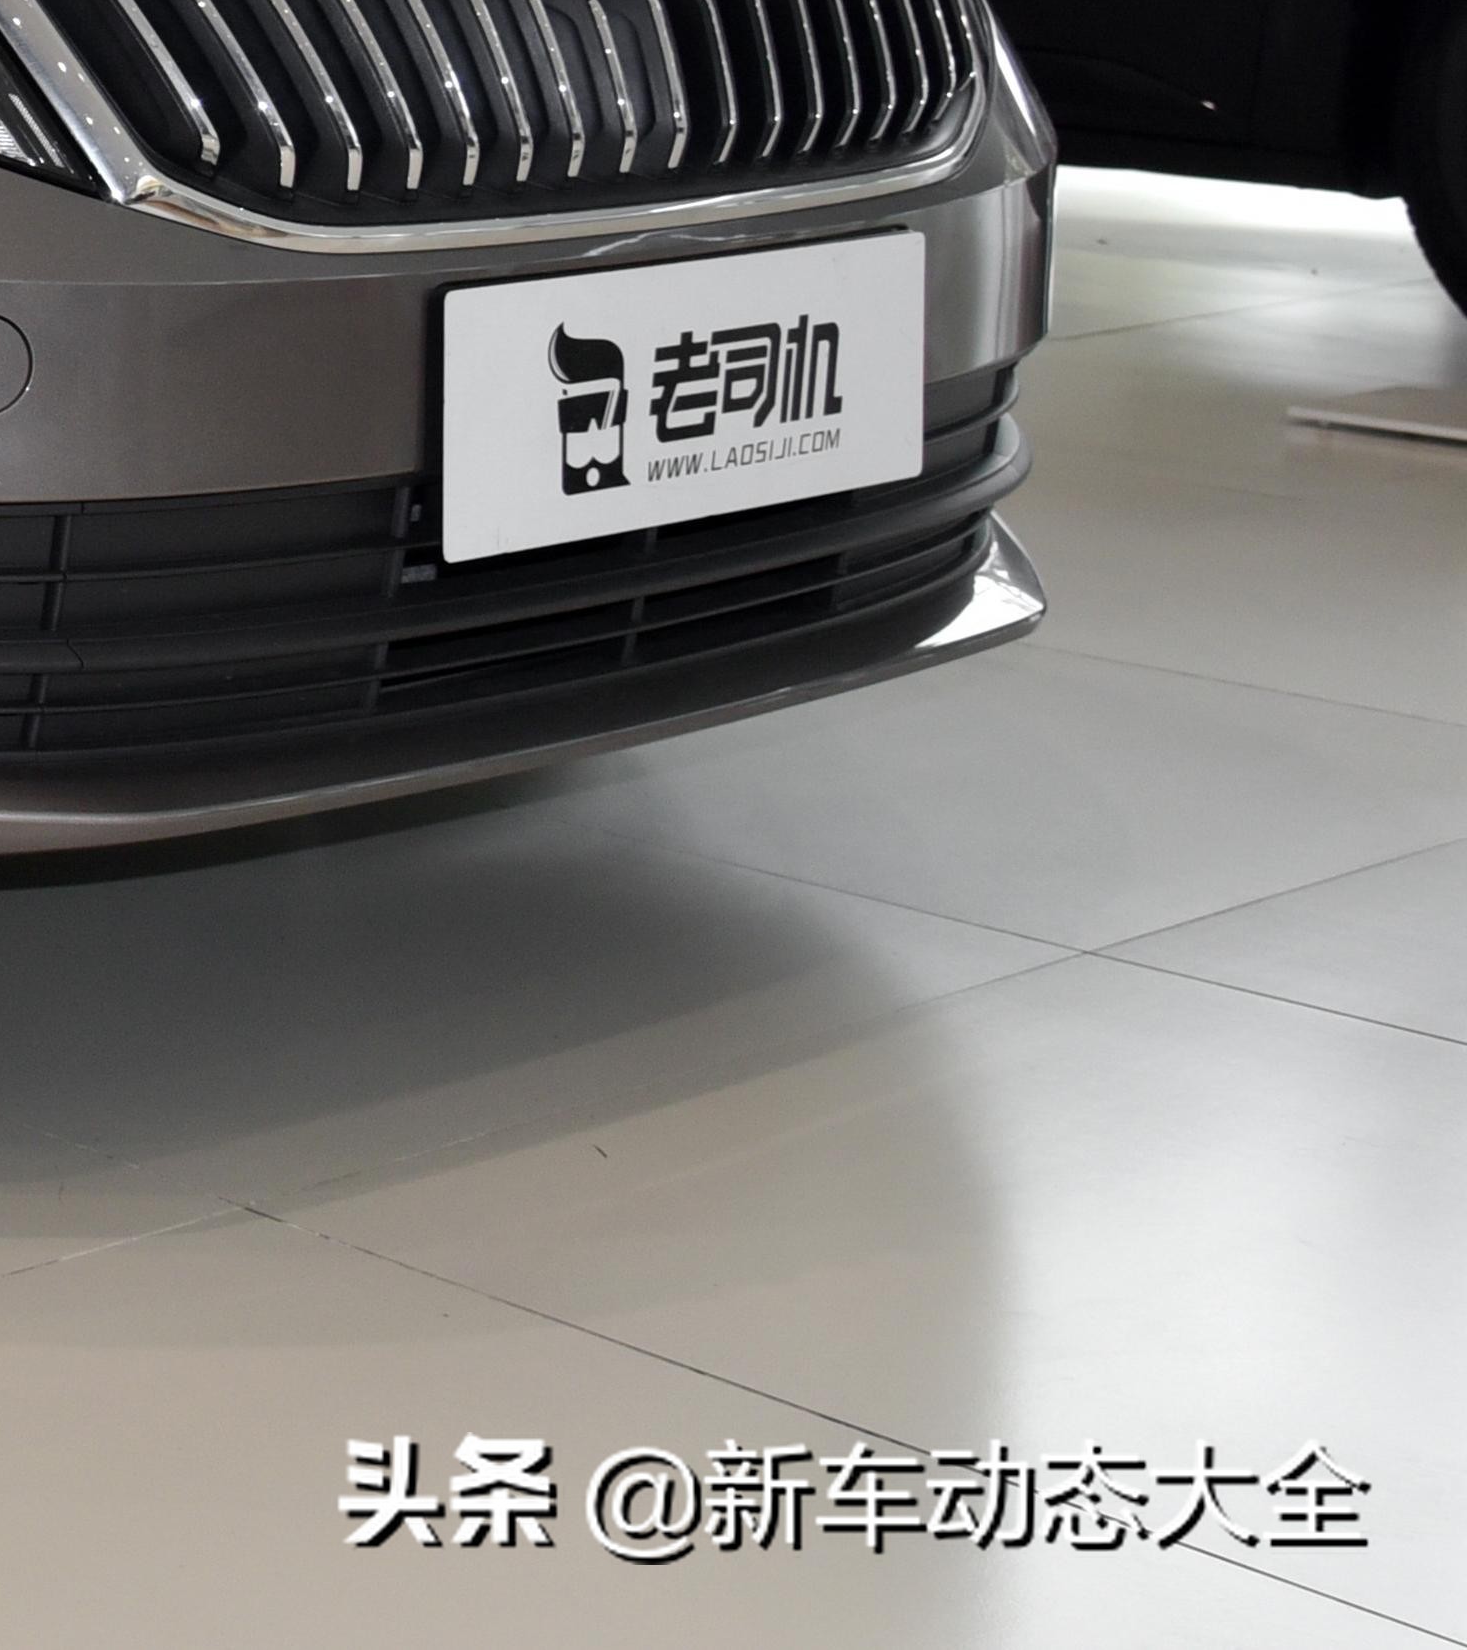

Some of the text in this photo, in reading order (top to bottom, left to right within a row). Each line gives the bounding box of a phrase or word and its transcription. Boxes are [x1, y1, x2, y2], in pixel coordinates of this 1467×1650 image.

[648, 313, 843, 444] 老司机
[646, 428, 842, 483] WWW.LAOSIJI.COM
